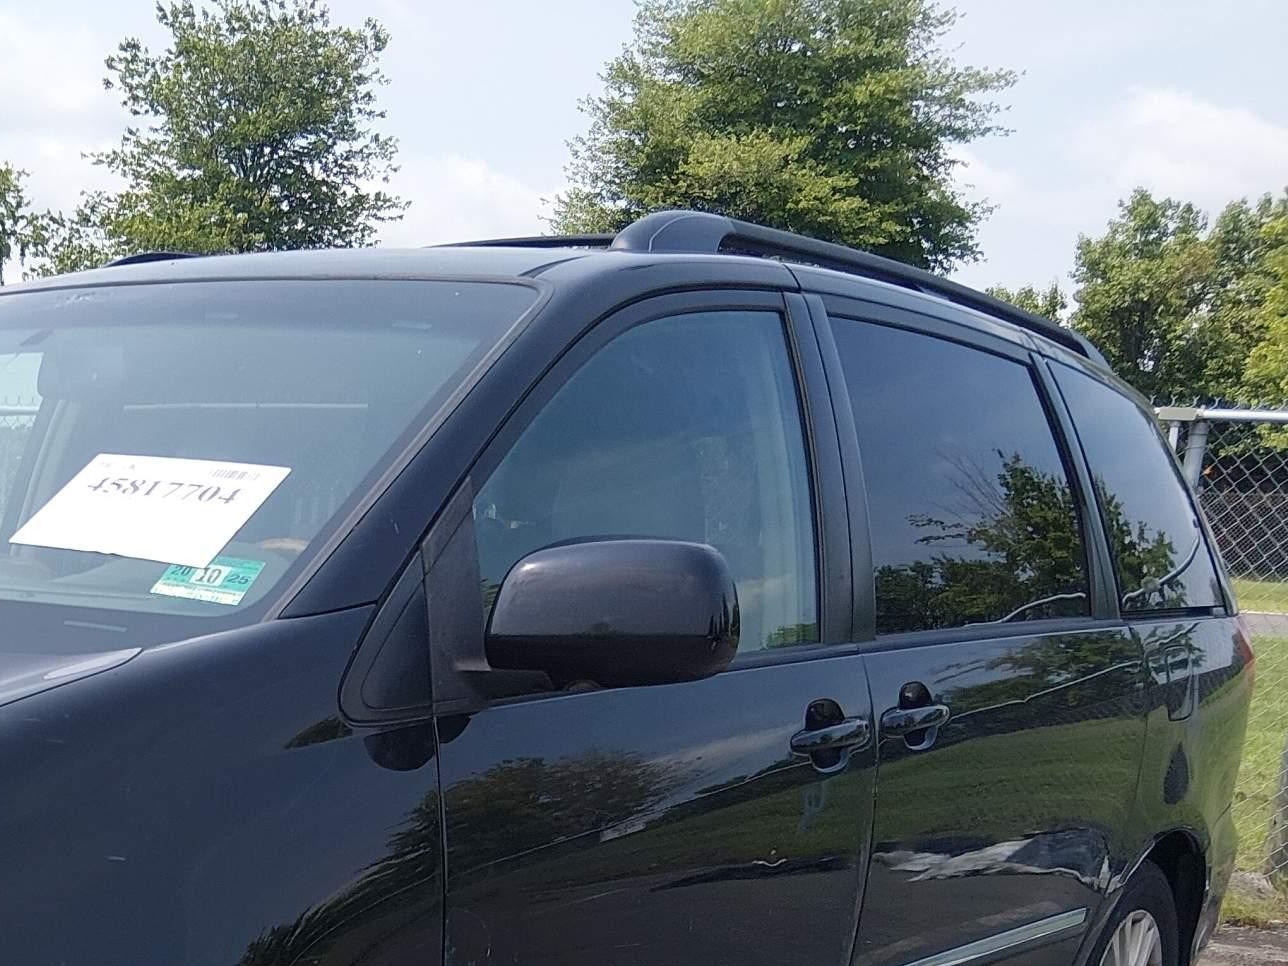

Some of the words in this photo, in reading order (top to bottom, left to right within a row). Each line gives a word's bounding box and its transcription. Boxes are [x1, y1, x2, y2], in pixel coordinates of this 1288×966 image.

[88, 476, 242, 504] 45817704
[171, 565, 192, 577] 20
[195, 567, 222, 584] 10
[226, 573, 250, 585] 25
